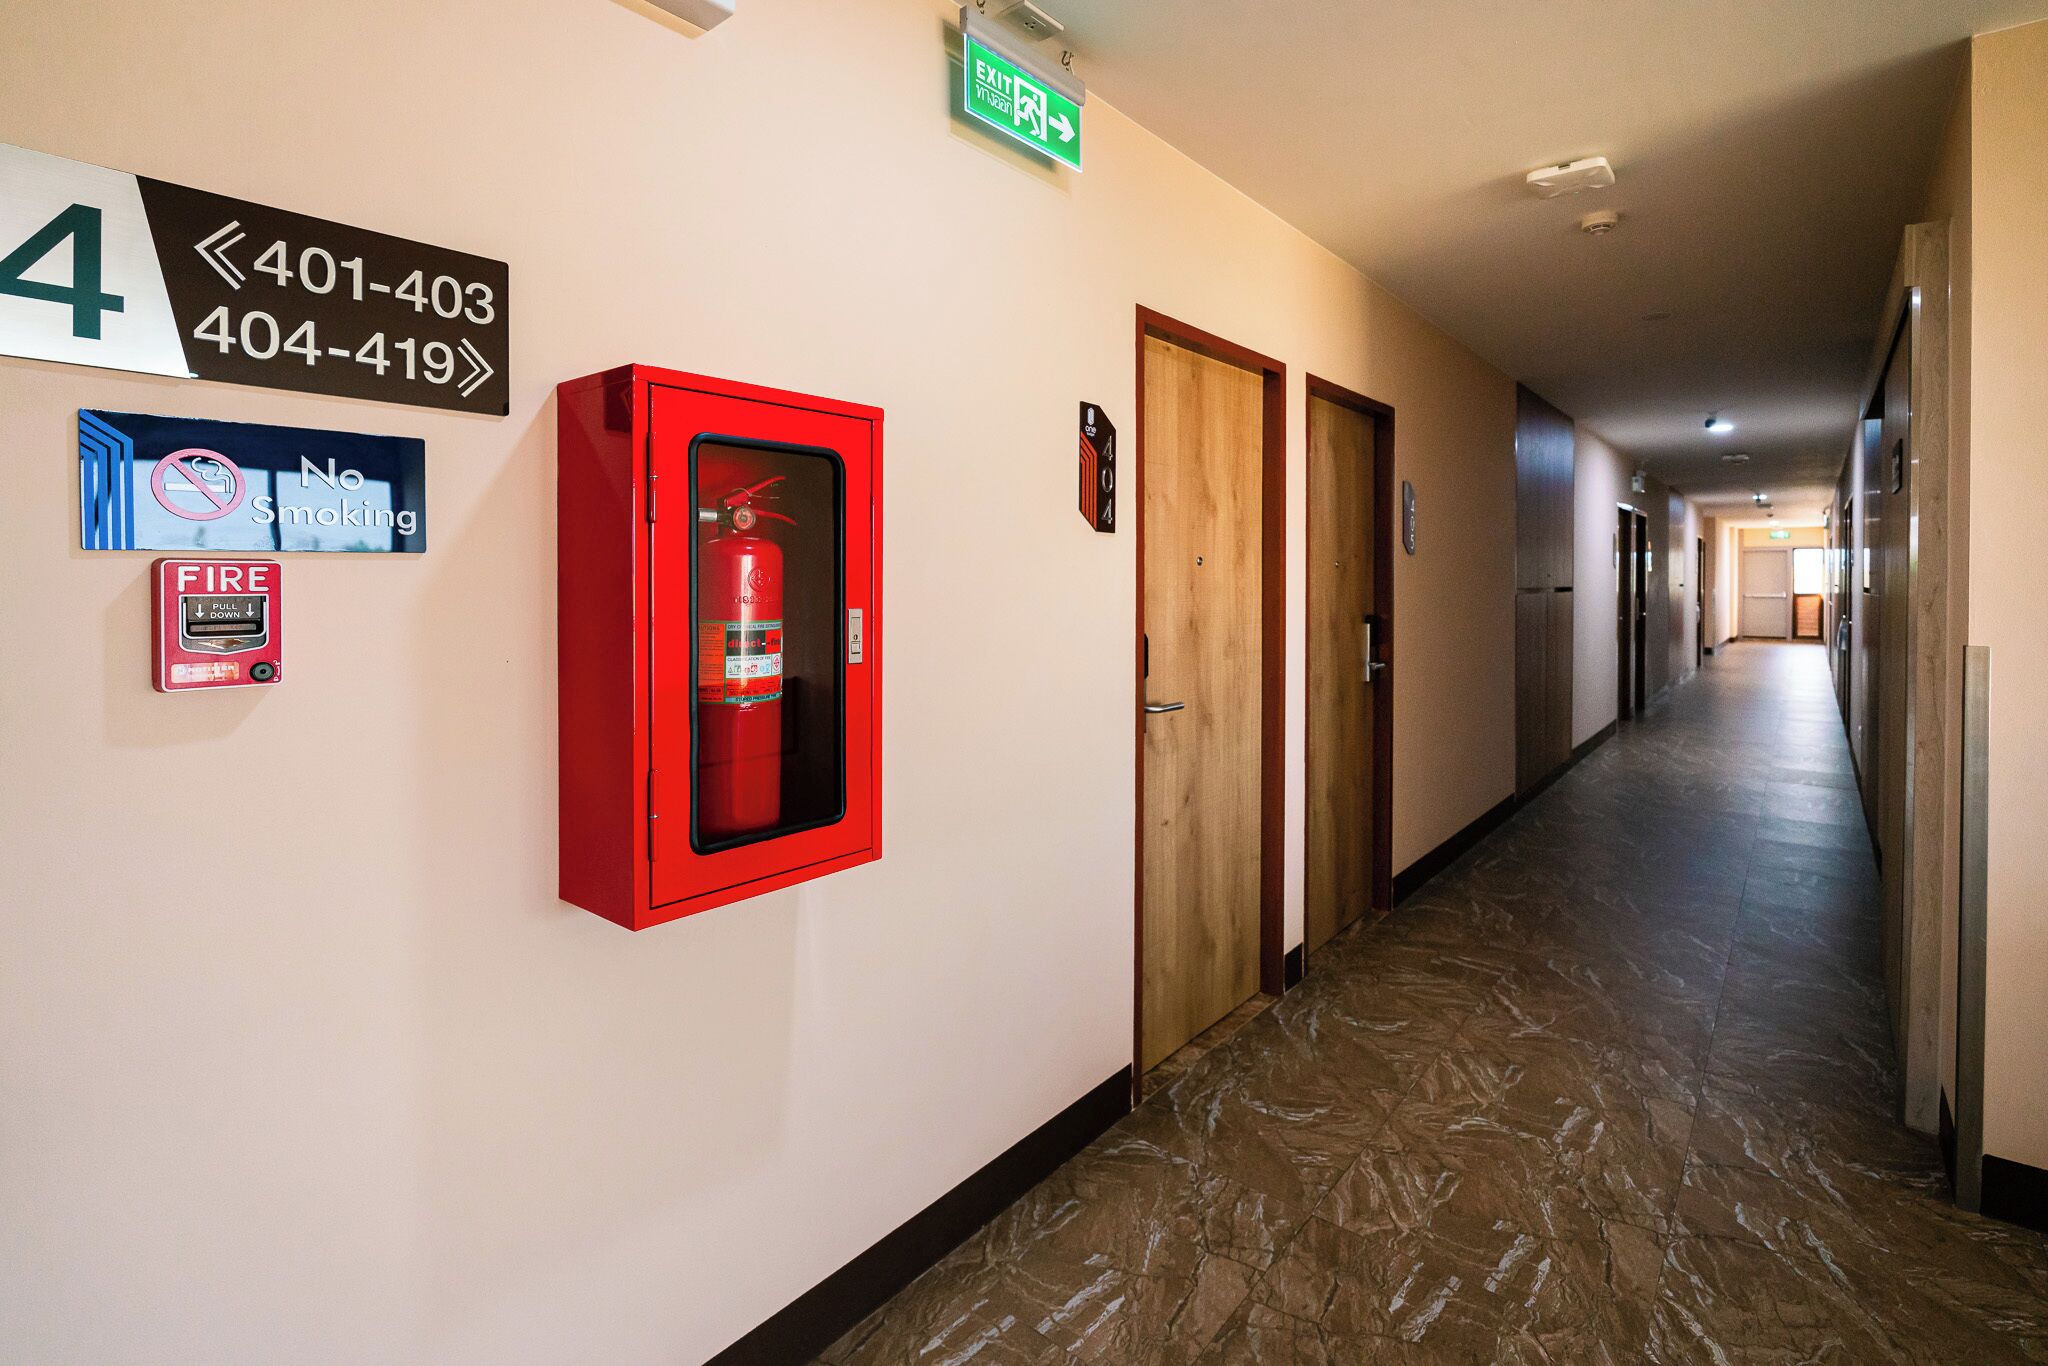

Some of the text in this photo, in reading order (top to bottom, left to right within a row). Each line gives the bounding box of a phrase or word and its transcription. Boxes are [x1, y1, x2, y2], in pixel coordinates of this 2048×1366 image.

[976, 58, 1013, 95] EXIT
[976, 84, 1013, 117] ทางออก
[0, 203, 124, 340] 4
[253, 240, 496, 325] 401-403
[193, 305, 455, 384] 404-419
[300, 454, 365, 492] No
[1102, 435, 1113, 524] 404
[251, 495, 417, 536] Smoking
[178, 566, 269, 592] FIRE
[210, 611, 240, 619] DOWN
